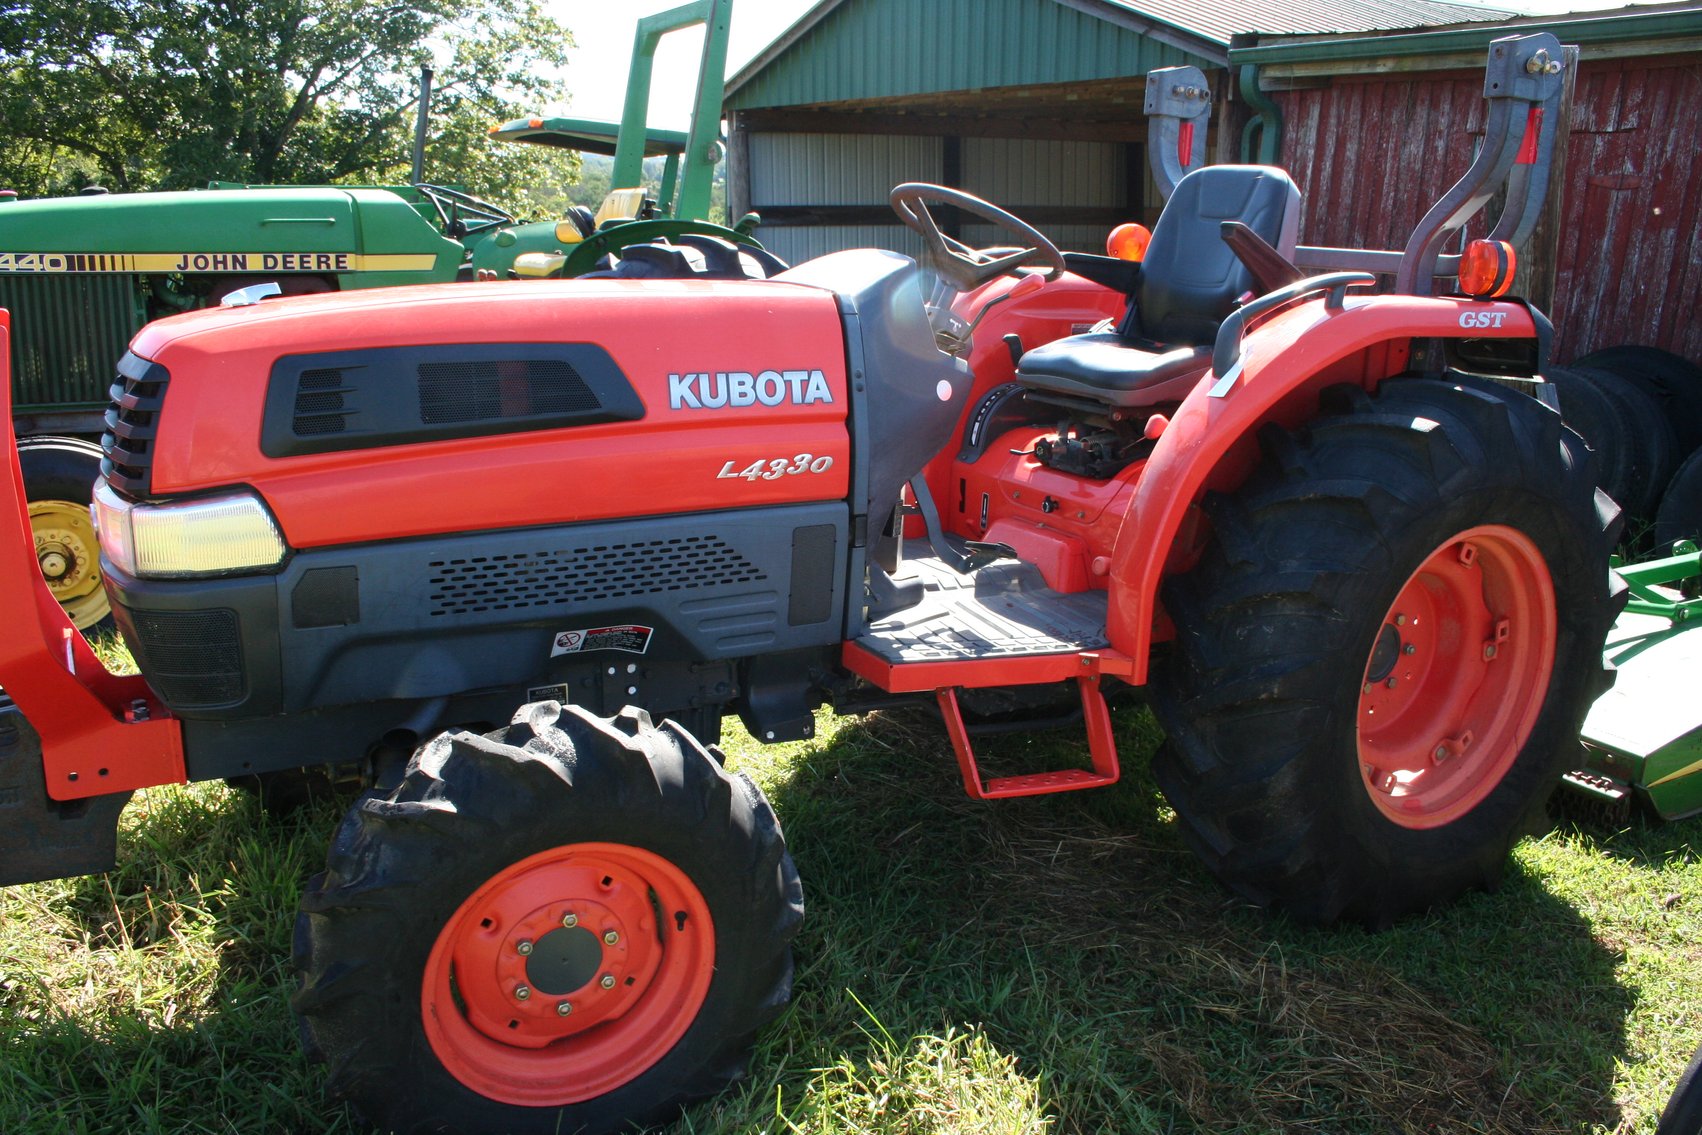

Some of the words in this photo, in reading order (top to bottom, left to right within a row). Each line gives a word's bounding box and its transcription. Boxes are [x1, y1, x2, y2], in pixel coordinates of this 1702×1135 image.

[0, 253, 68, 271] 440
[176, 254, 248, 271] JOHN
[263, 254, 348, 270] DEERE
[1458, 311, 1507, 329] GST
[668, 370, 833, 410] KUBOTA
[716, 453, 834, 482] L4330
